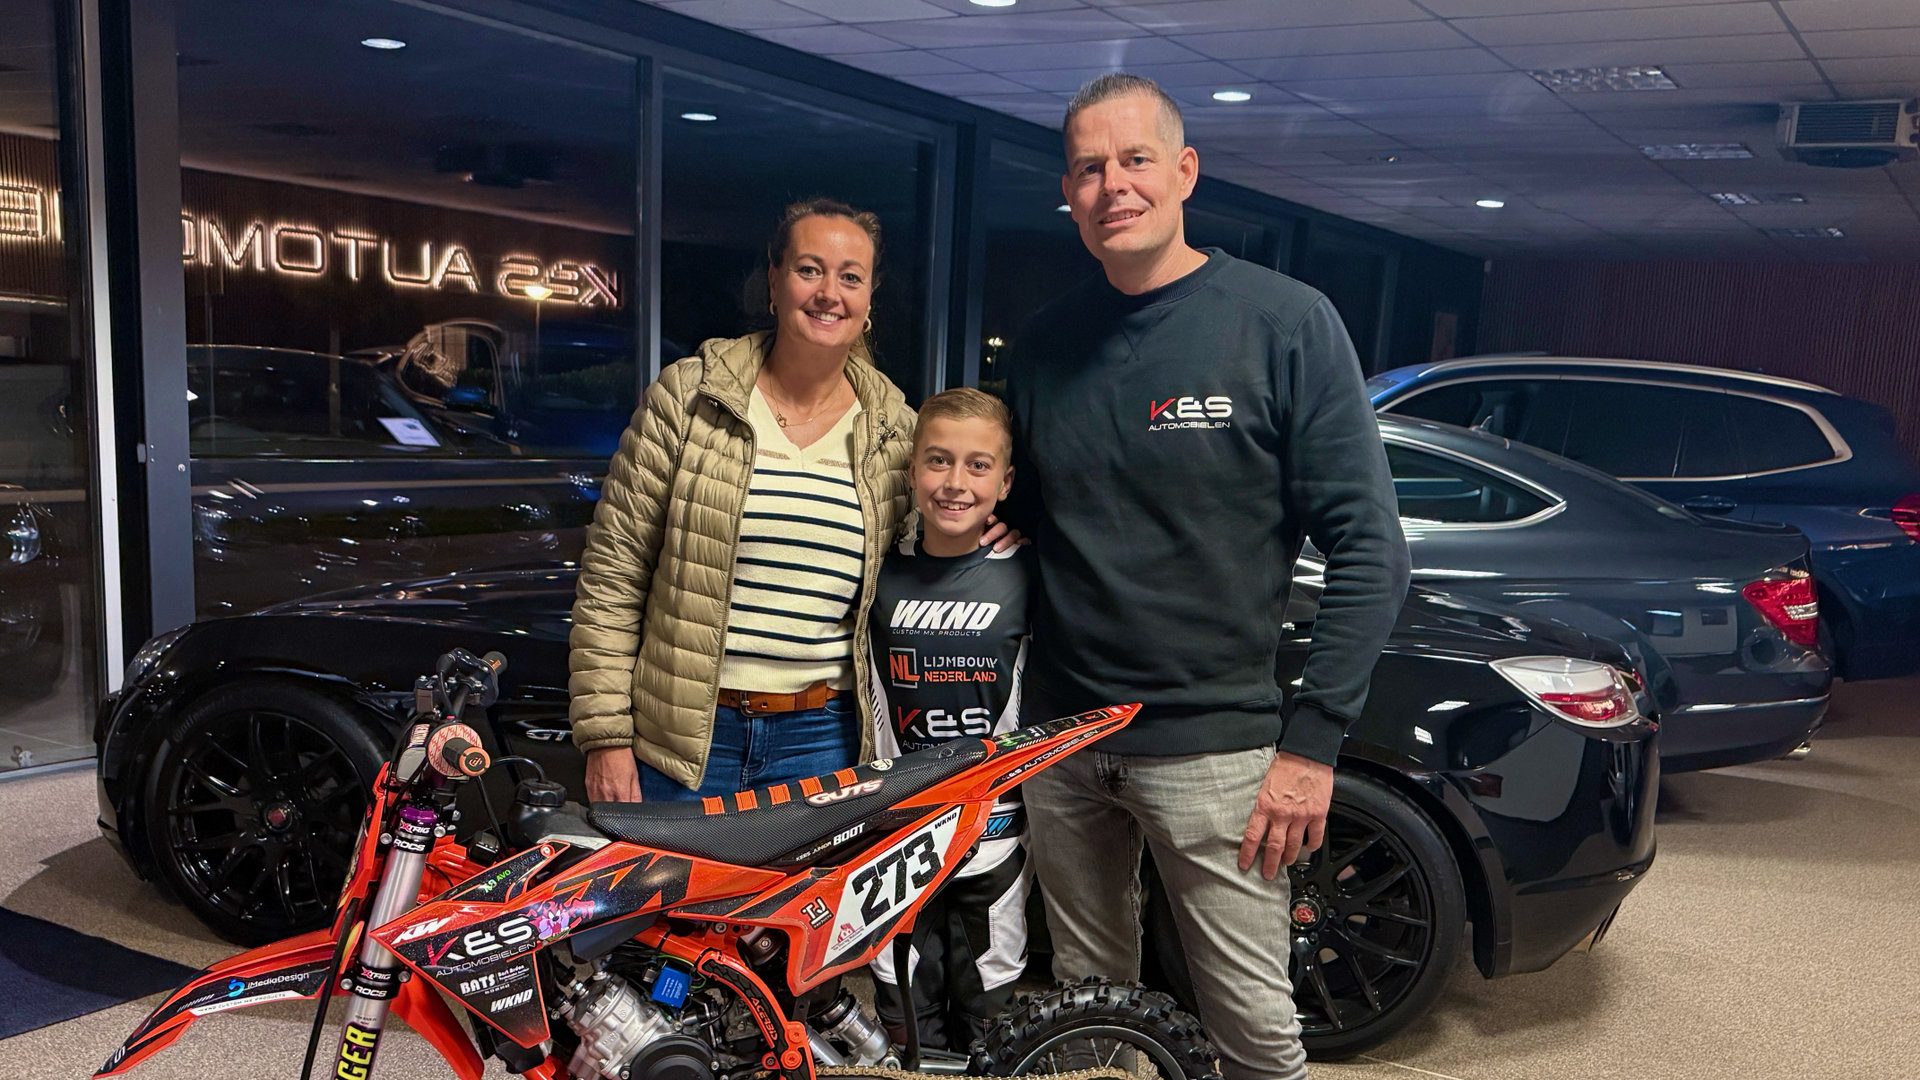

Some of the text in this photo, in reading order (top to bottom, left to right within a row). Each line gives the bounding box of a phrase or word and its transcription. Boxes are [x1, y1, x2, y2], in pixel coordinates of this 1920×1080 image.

[1149, 396, 1233, 421] K&S
[1148, 421, 1231, 431] AUTOMOBIELEN
[889, 599, 1001, 630] WKND
[892, 628, 921, 636] CUSTOM
[889, 653, 921, 682] NL
[923, 656, 998, 668] LIJMBOUW
[924, 671, 997, 682] NEDERLAND
[897, 706, 991, 738] K&S
[1024, 730, 1099, 771] AUTOMOBIELEN
[807, 779, 884, 805] GUTS
[934, 812, 958, 830] WKND
[393, 838, 426, 852] ROCS
[832, 822, 866, 846] BOOT
[851, 830, 942, 928] 273
[426, 916, 533, 967] K&S
[435, 941, 538, 978] AUTOMOBIELEN
[355, 985, 388, 998] ROCS
[460, 973, 496, 995] BATS
[491, 988, 534, 1013] WKND
